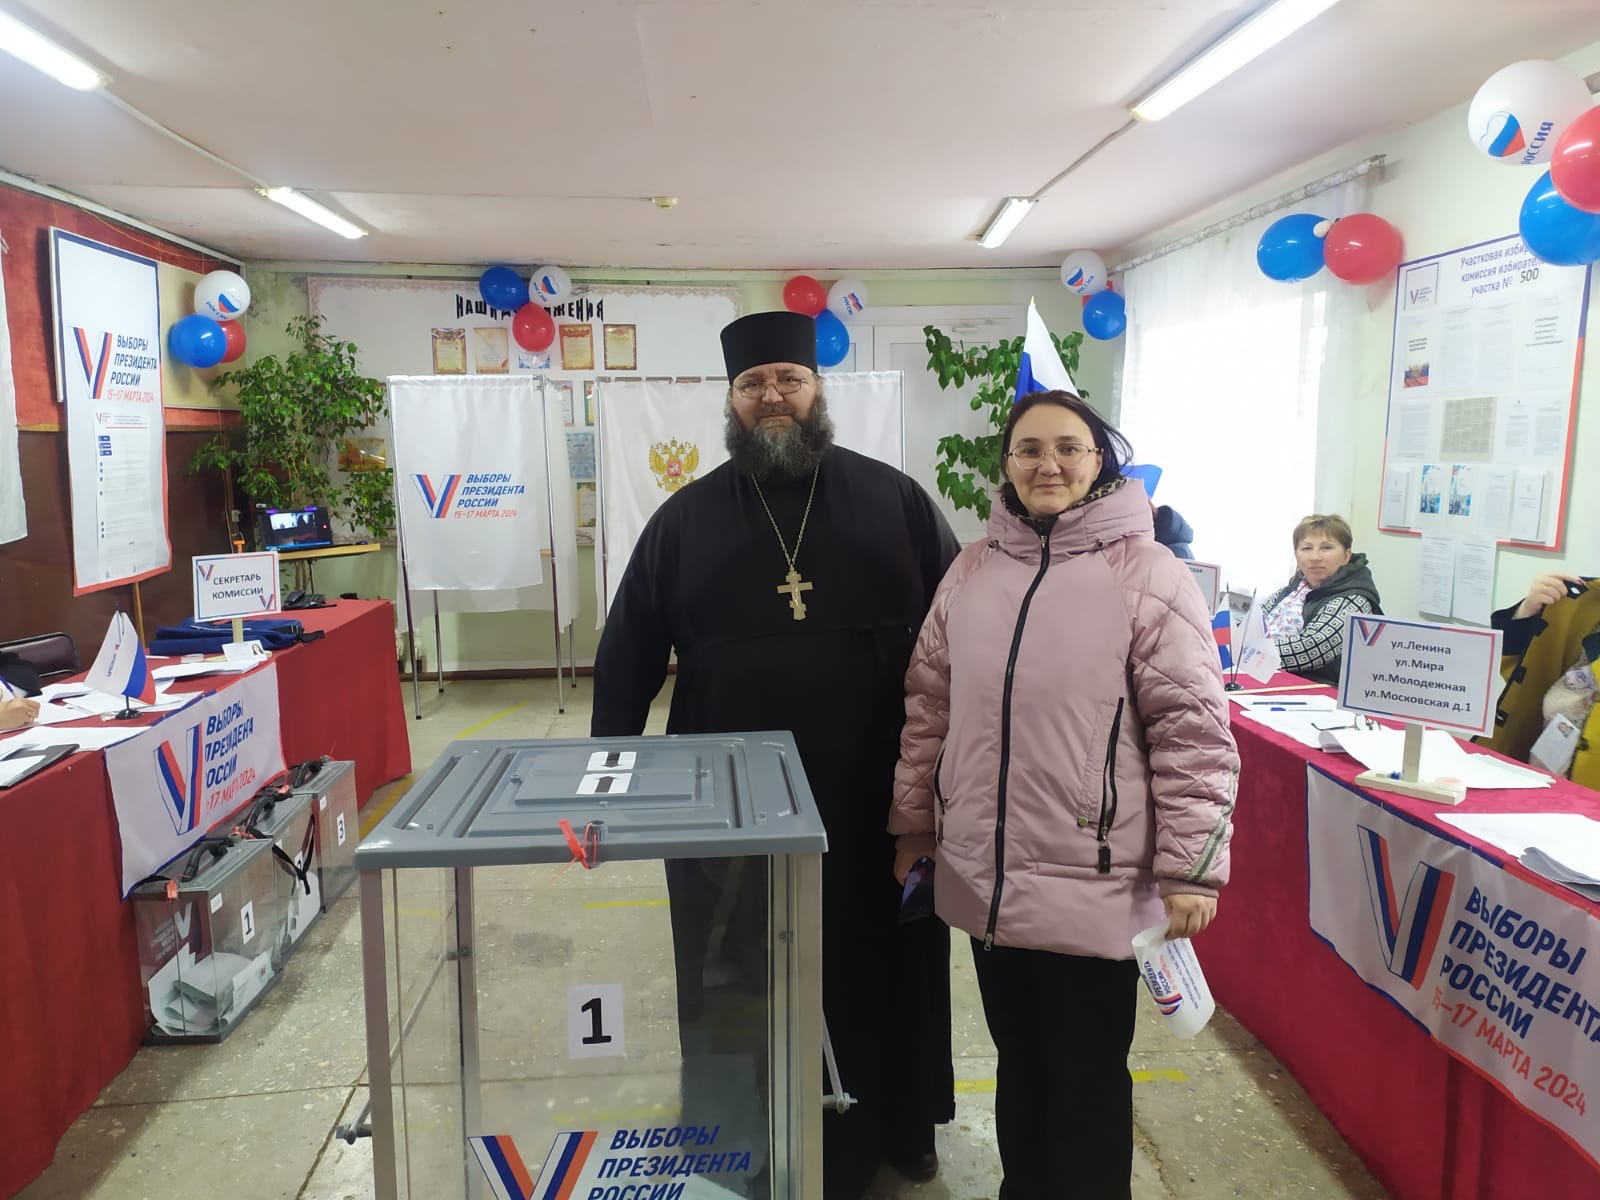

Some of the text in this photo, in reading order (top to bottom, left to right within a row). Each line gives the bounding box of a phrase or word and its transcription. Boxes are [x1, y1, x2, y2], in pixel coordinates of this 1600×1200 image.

[1521, 121, 1554, 164] РОССИЯ
[1461, 250, 1503, 268] Участковая
[1461, 267, 1496, 282] комиссия
[1471, 281, 1500, 298] участка
[1520, 268, 1539, 283] 500
[117, 335, 148, 351] ВЫБОРЫ
[114, 353, 157, 370] ПРЕЗИДЕНТА
[110, 372, 141, 386] РОССИИ
[467, 473, 511, 483] ВЫБОРЫ
[461, 485, 525, 496] ПРЕЗИДЕНТА
[457, 498, 499, 508] РОССИИ
[476, 509, 499, 518] МАРТА
[213, 573, 261, 585] СЕКРЕТАРЬ
[212, 587, 263, 600] КОМИССИИ
[1391, 640, 1451, 655] ул.Ленина
[1395, 658, 1444, 672] ул.Мира
[1372, 672, 1466, 693] ул.Молодежная
[1364, 689, 1471, 712] ул.Московская д.1
[205, 754, 237, 788] ОССИИ
[338, 820, 344, 840] 3
[244, 911, 252, 935] 1
[1464, 886, 1586, 975] ВЫБОРЫ
[1439, 954, 1533, 1039] РОССИИ
[580, 997, 612, 1045] 1
[1476, 1017, 1531, 1080] МАРТА
[1533, 1066, 1586, 1116] 2024
[610, 1124, 720, 1150] ВЫБОРЫ
[597, 1151, 751, 1179] ПРЕЗИДЕНТА
[587, 1182, 686, 1200] РОССИИ
